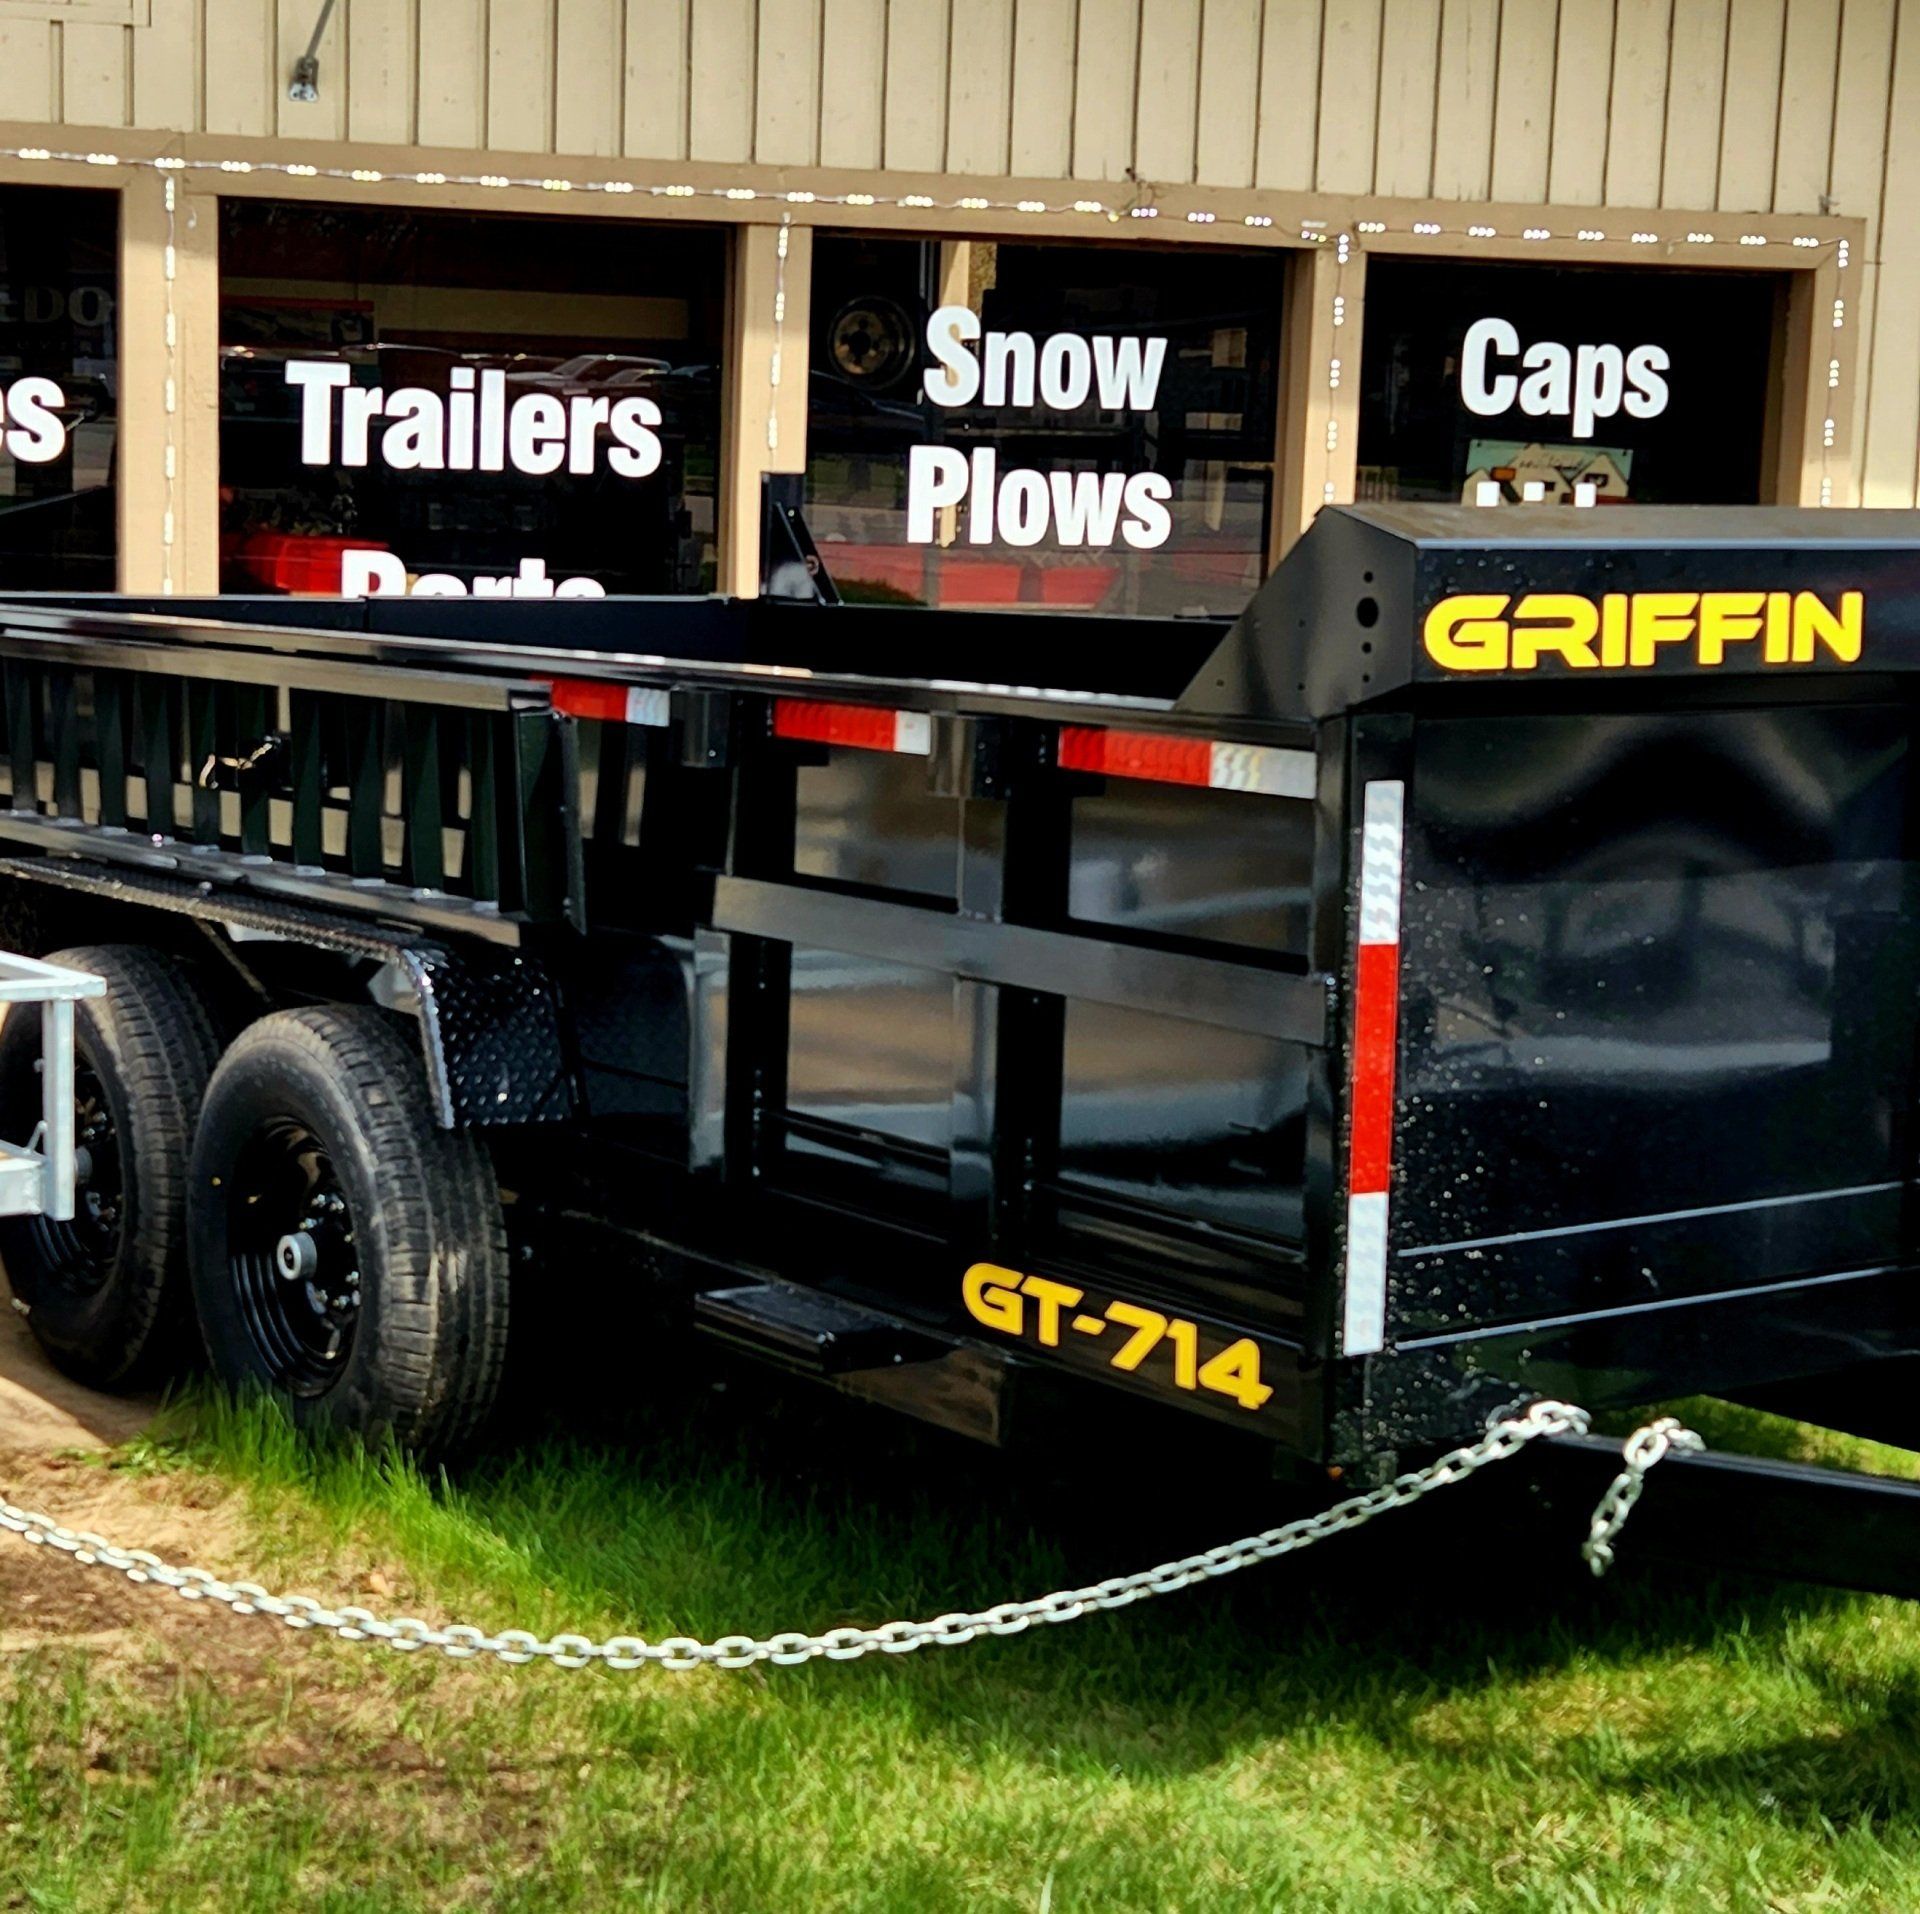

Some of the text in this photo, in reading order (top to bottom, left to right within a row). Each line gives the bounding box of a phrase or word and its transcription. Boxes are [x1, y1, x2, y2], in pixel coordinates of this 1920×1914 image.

[923, 305, 1167, 411] Snow
[1461, 318, 1670, 438] Caps
[0, 377, 65, 462] s
[285, 360, 662, 478] Trailers
[907, 445, 1172, 549] Plows
[1423, 591, 1863, 670] GRIFFIN
[962, 1263, 1273, 1410] GT-714
